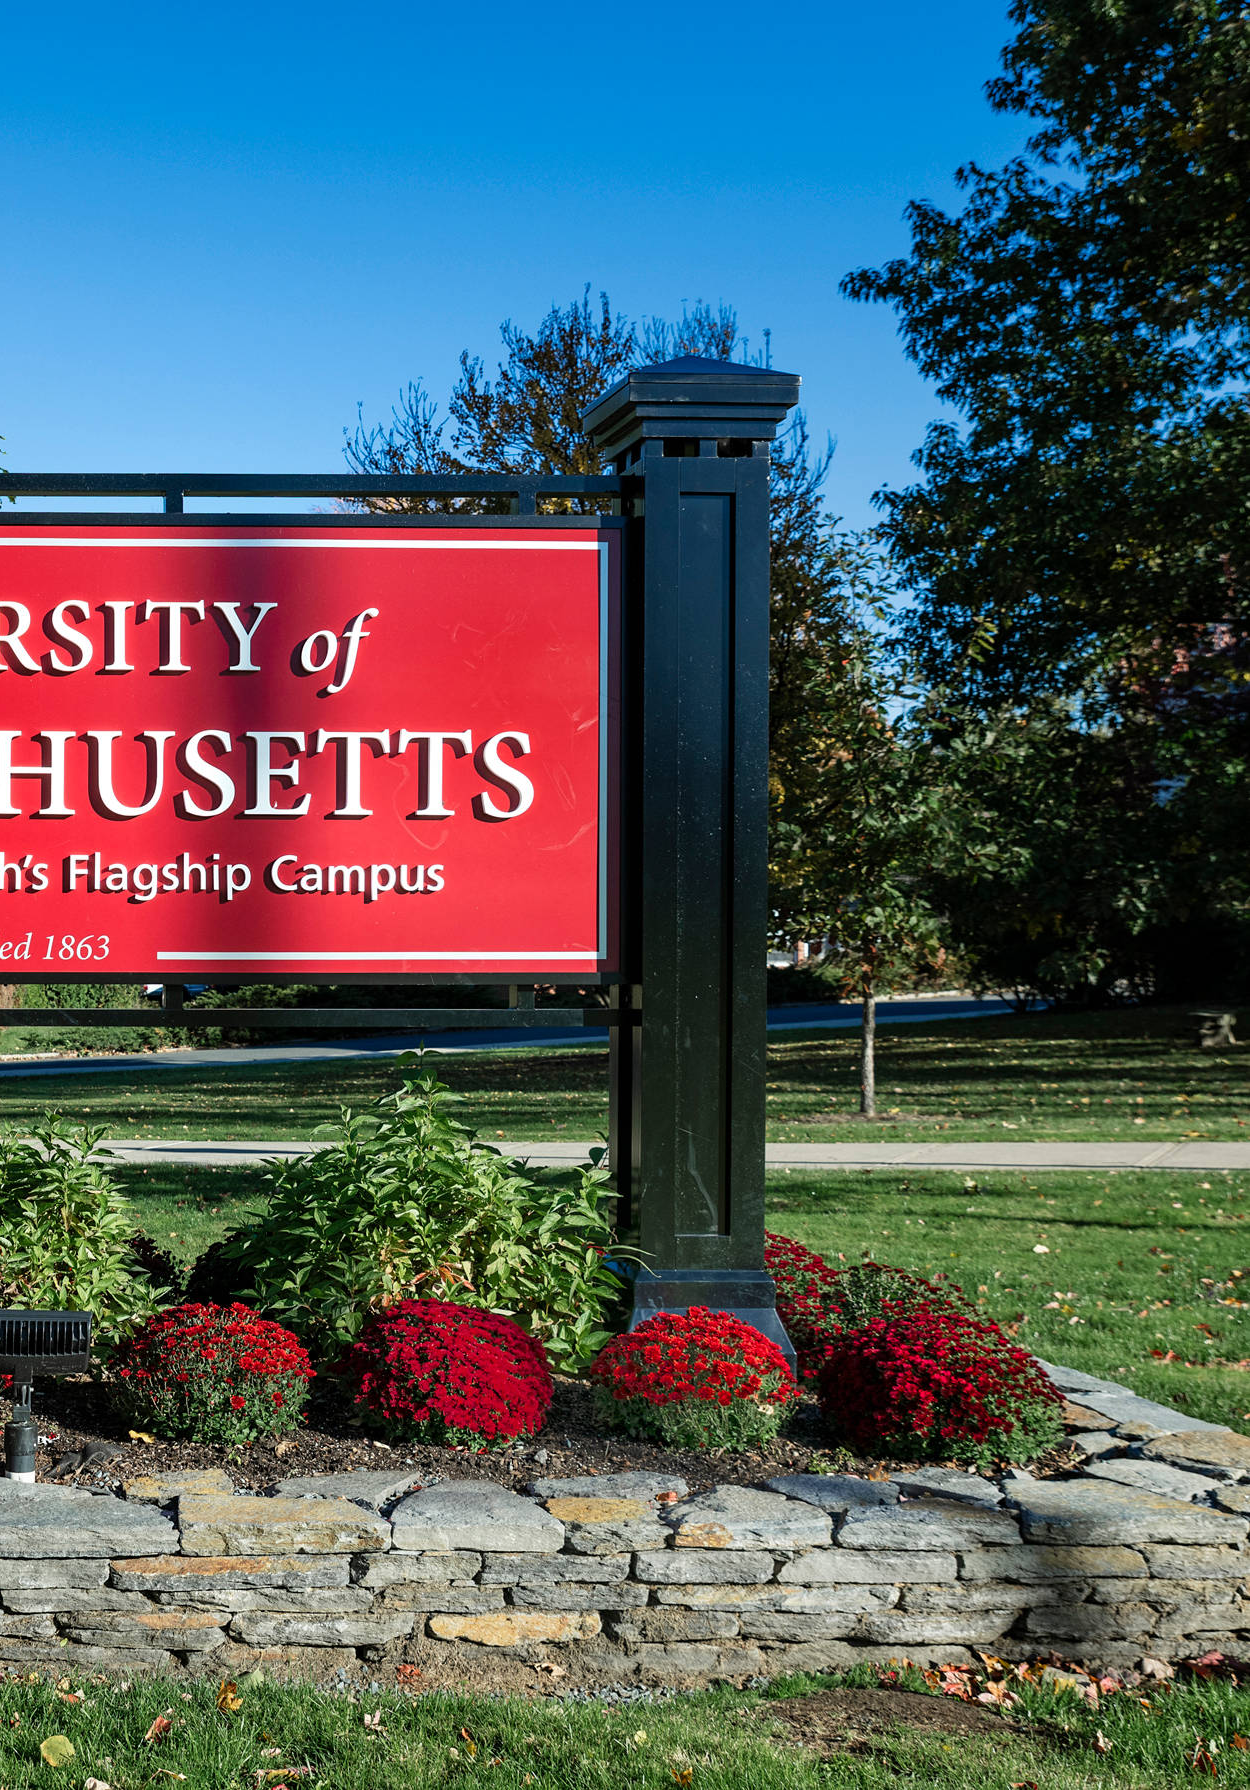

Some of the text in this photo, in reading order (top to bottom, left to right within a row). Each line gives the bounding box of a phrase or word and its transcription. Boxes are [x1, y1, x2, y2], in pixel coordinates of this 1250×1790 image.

[300, 606, 380, 694] of
[69, 850, 252, 902] Flagship
[271, 853, 447, 902] Campus
[42, 932, 111, 961] 1863
